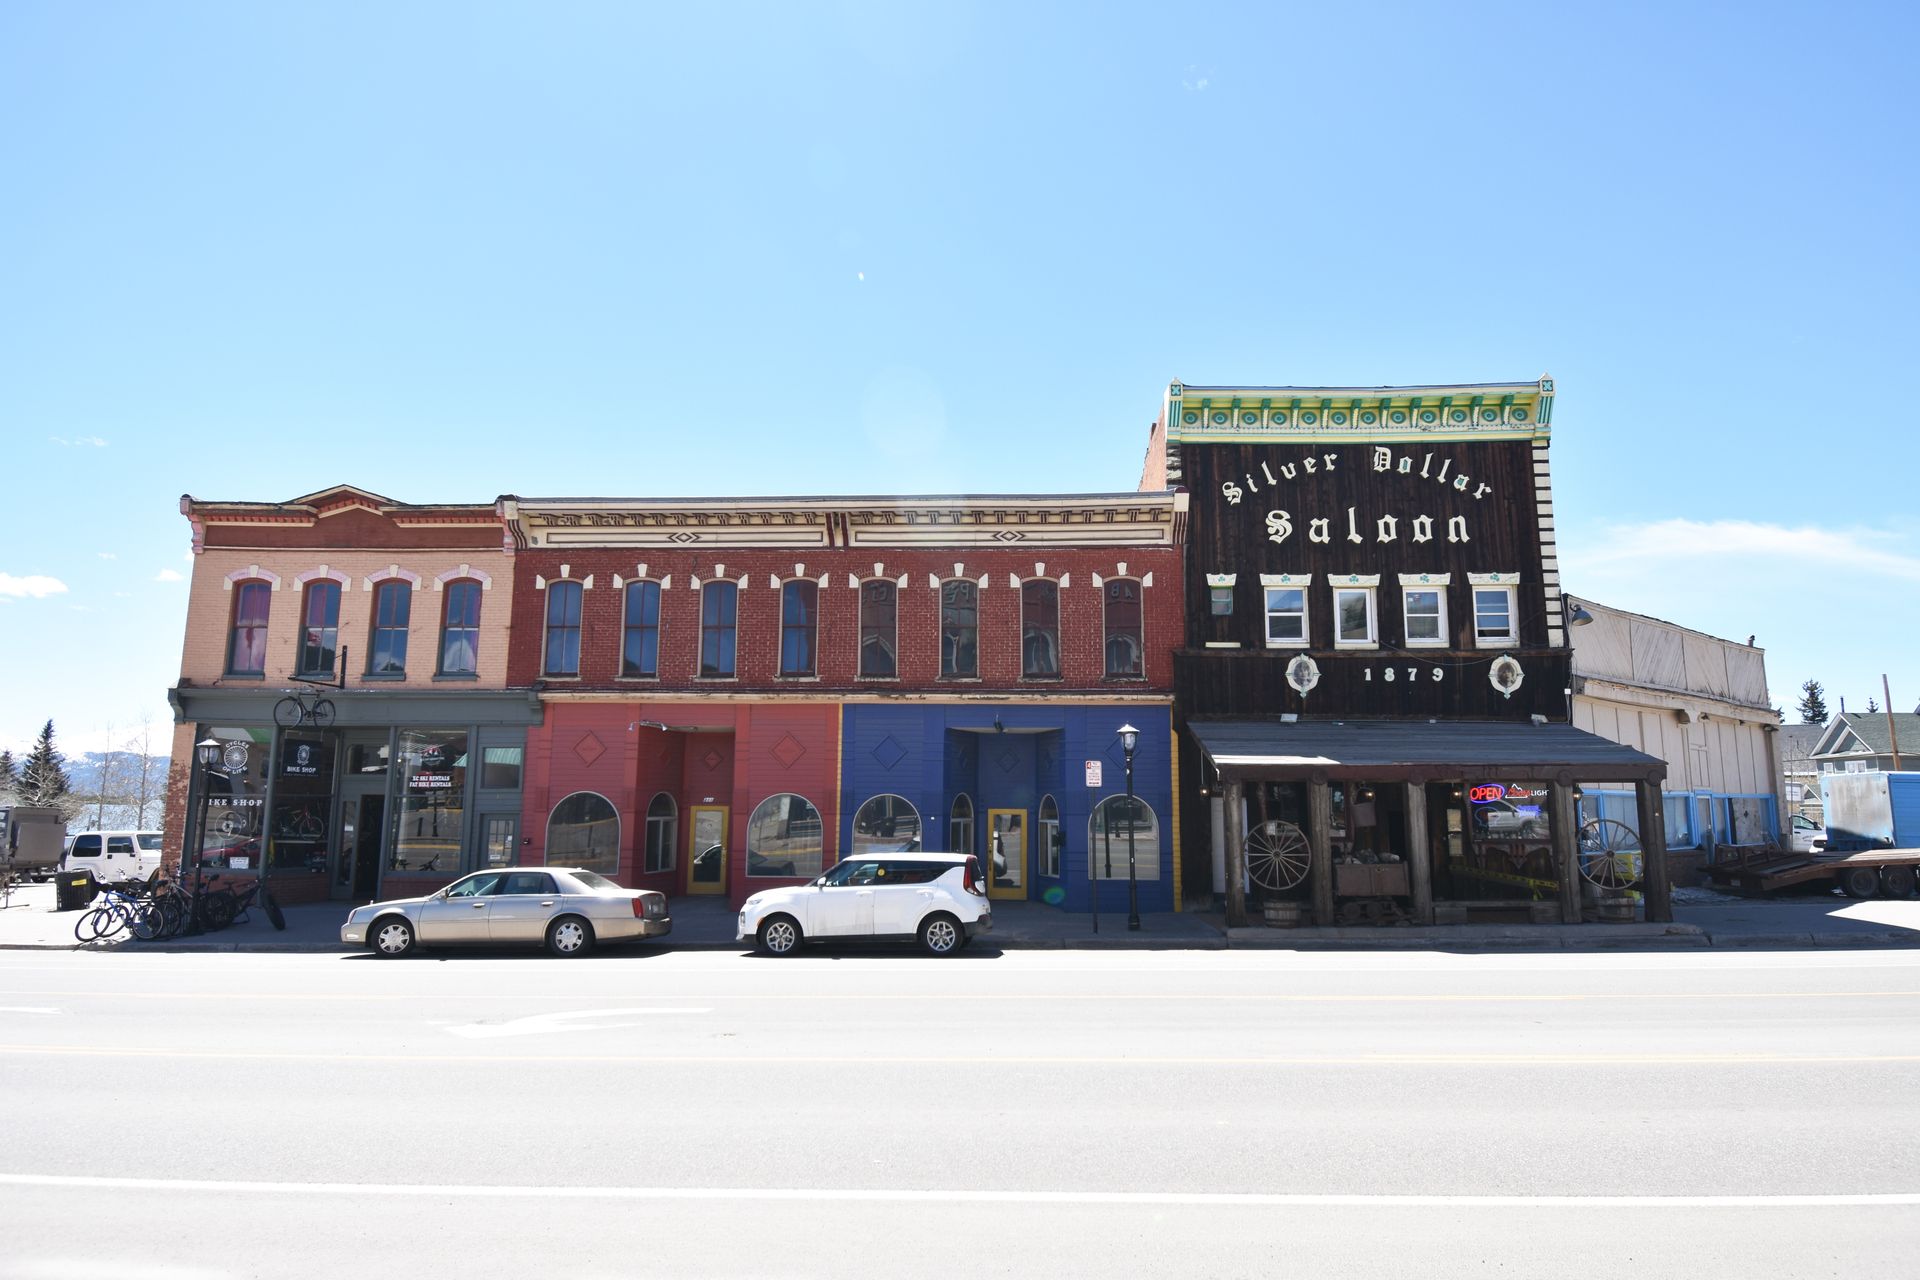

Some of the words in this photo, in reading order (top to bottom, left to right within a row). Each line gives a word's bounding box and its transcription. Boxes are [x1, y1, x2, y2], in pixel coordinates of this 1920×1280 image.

[1222, 453, 1337, 505] Silver
[1373, 446, 1492, 499] Dollar
[1265, 507, 1470, 544] Saloon
[1364, 667, 1444, 682] 1879
[225, 740, 250, 749] CYCLES
[222, 765, 232, 773] OF
[286, 765, 300, 773] BIKE
[302, 766, 316, 774] SHOP
[1469, 787, 1501, 800] OPEN
